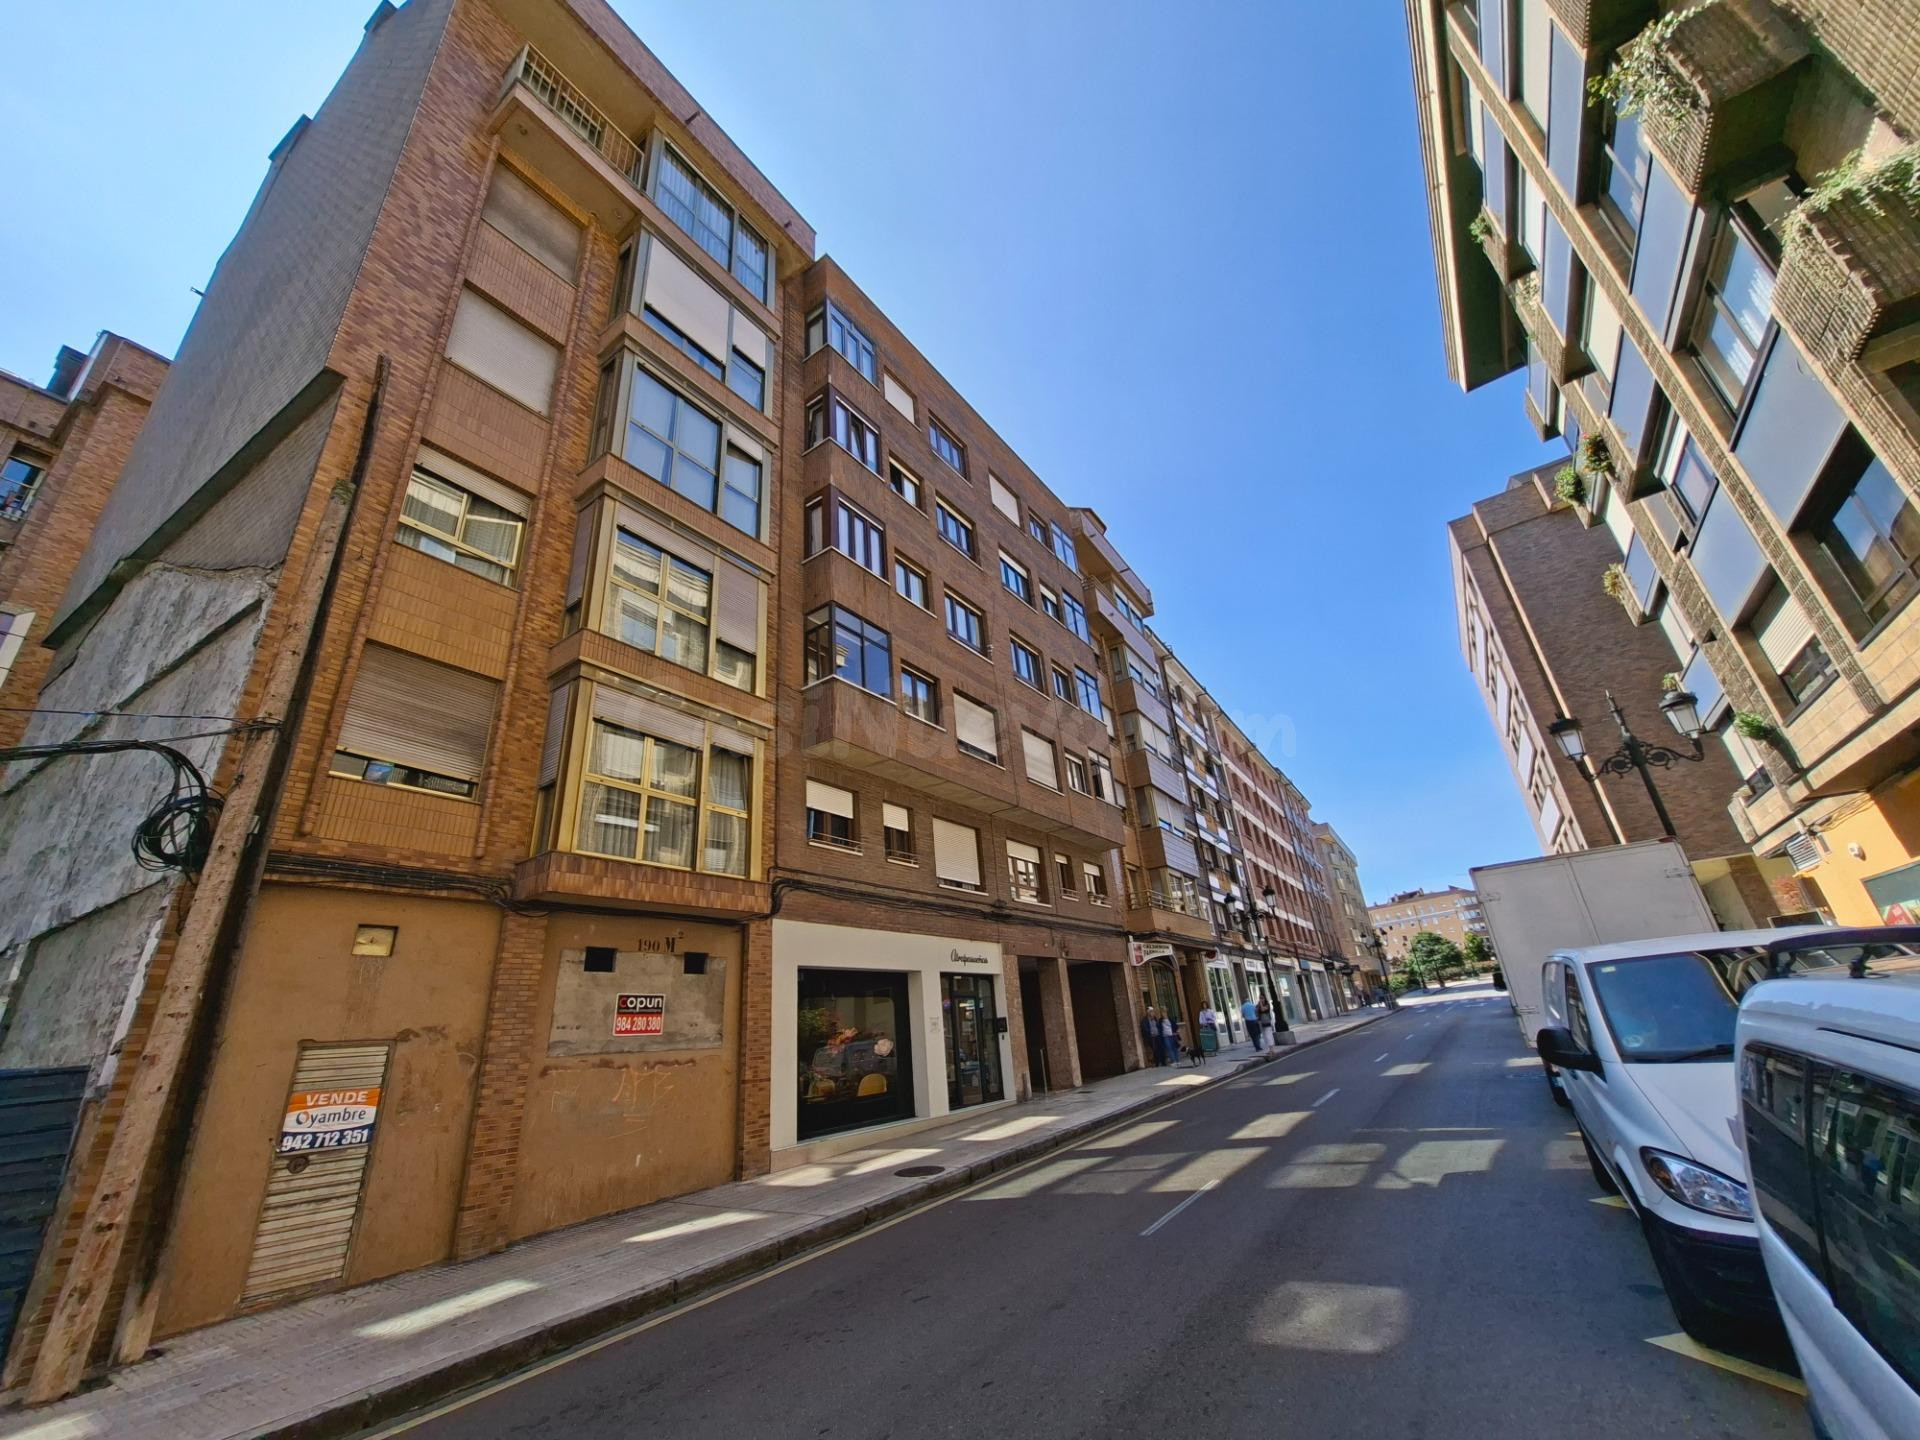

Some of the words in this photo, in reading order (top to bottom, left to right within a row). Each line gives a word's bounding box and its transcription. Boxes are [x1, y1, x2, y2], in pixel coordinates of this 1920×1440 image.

[619, 997, 662, 1012] copun
[615, 1016, 631, 1031] 984
[632, 1016, 646, 1031] 280
[647, 1016, 661, 1031] 380
[306, 1091, 368, 1106] VENDE
[296, 1107, 366, 1128] Oyambre
[281, 1134, 312, 1152] 942
[315, 1131, 341, 1148] 712
[341, 1129, 369, 1145] 351
